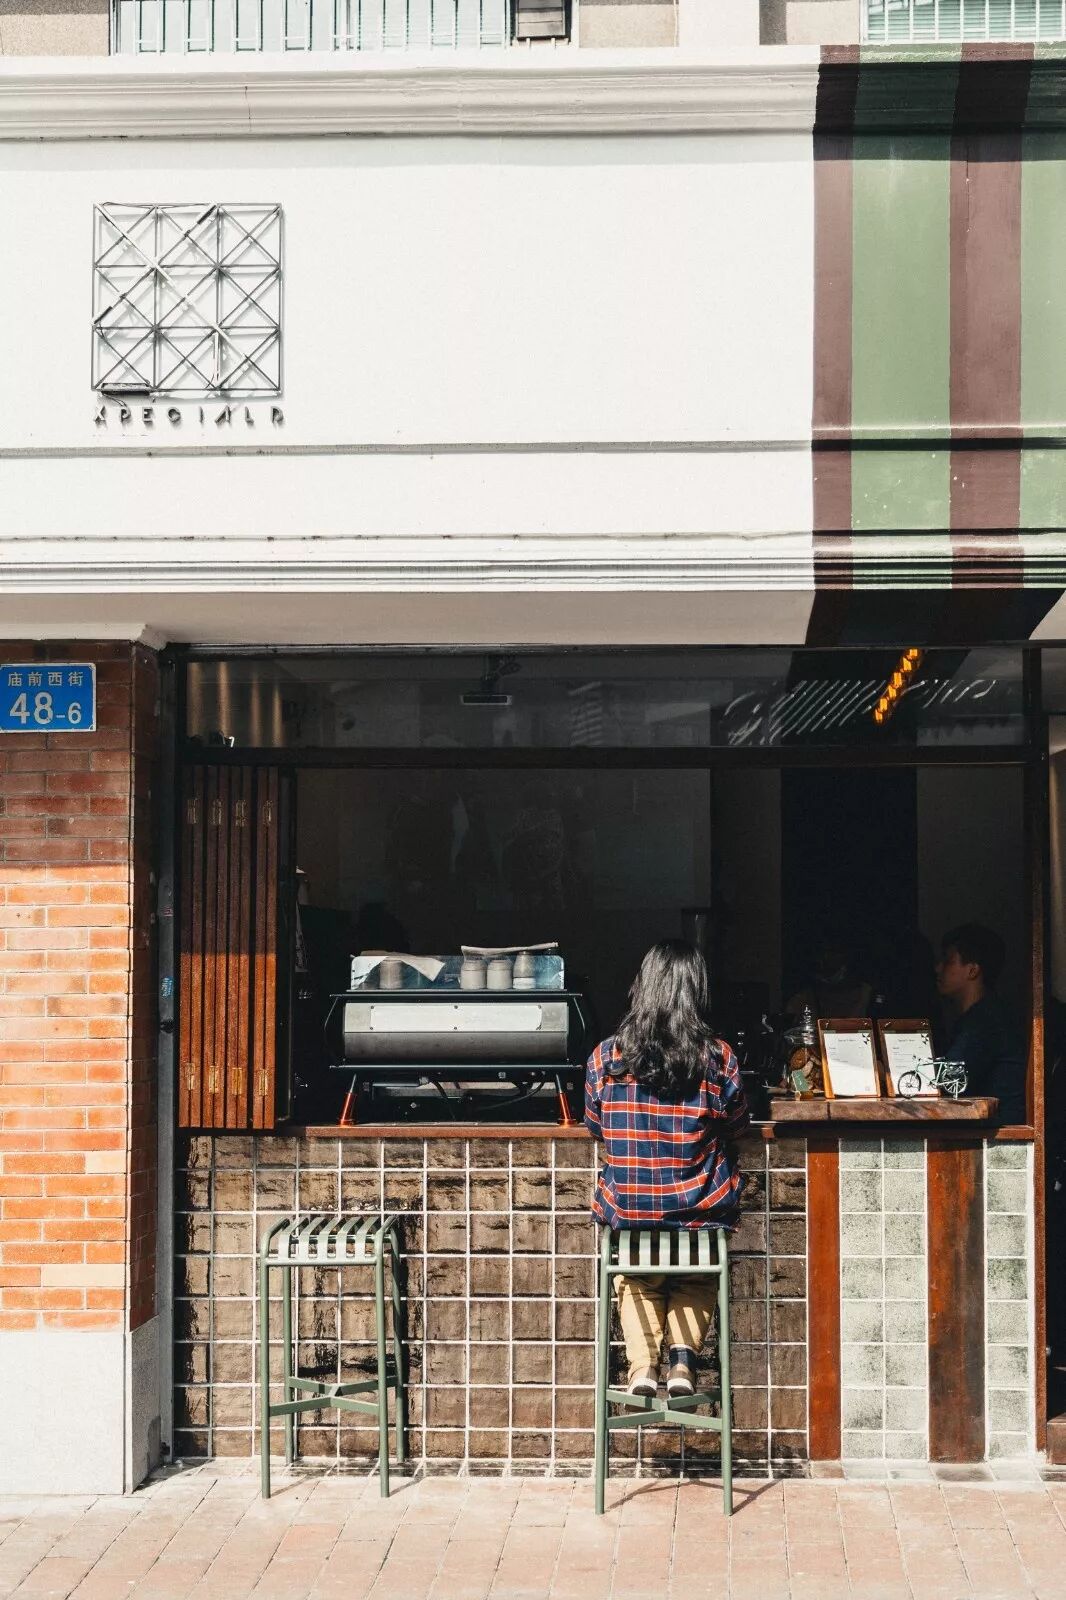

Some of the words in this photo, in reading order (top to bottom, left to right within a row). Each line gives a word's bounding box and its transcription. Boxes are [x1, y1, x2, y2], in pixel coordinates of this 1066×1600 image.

[8, 671, 83, 686] 庙前西街
[10, 692, 82, 724] 48-6
